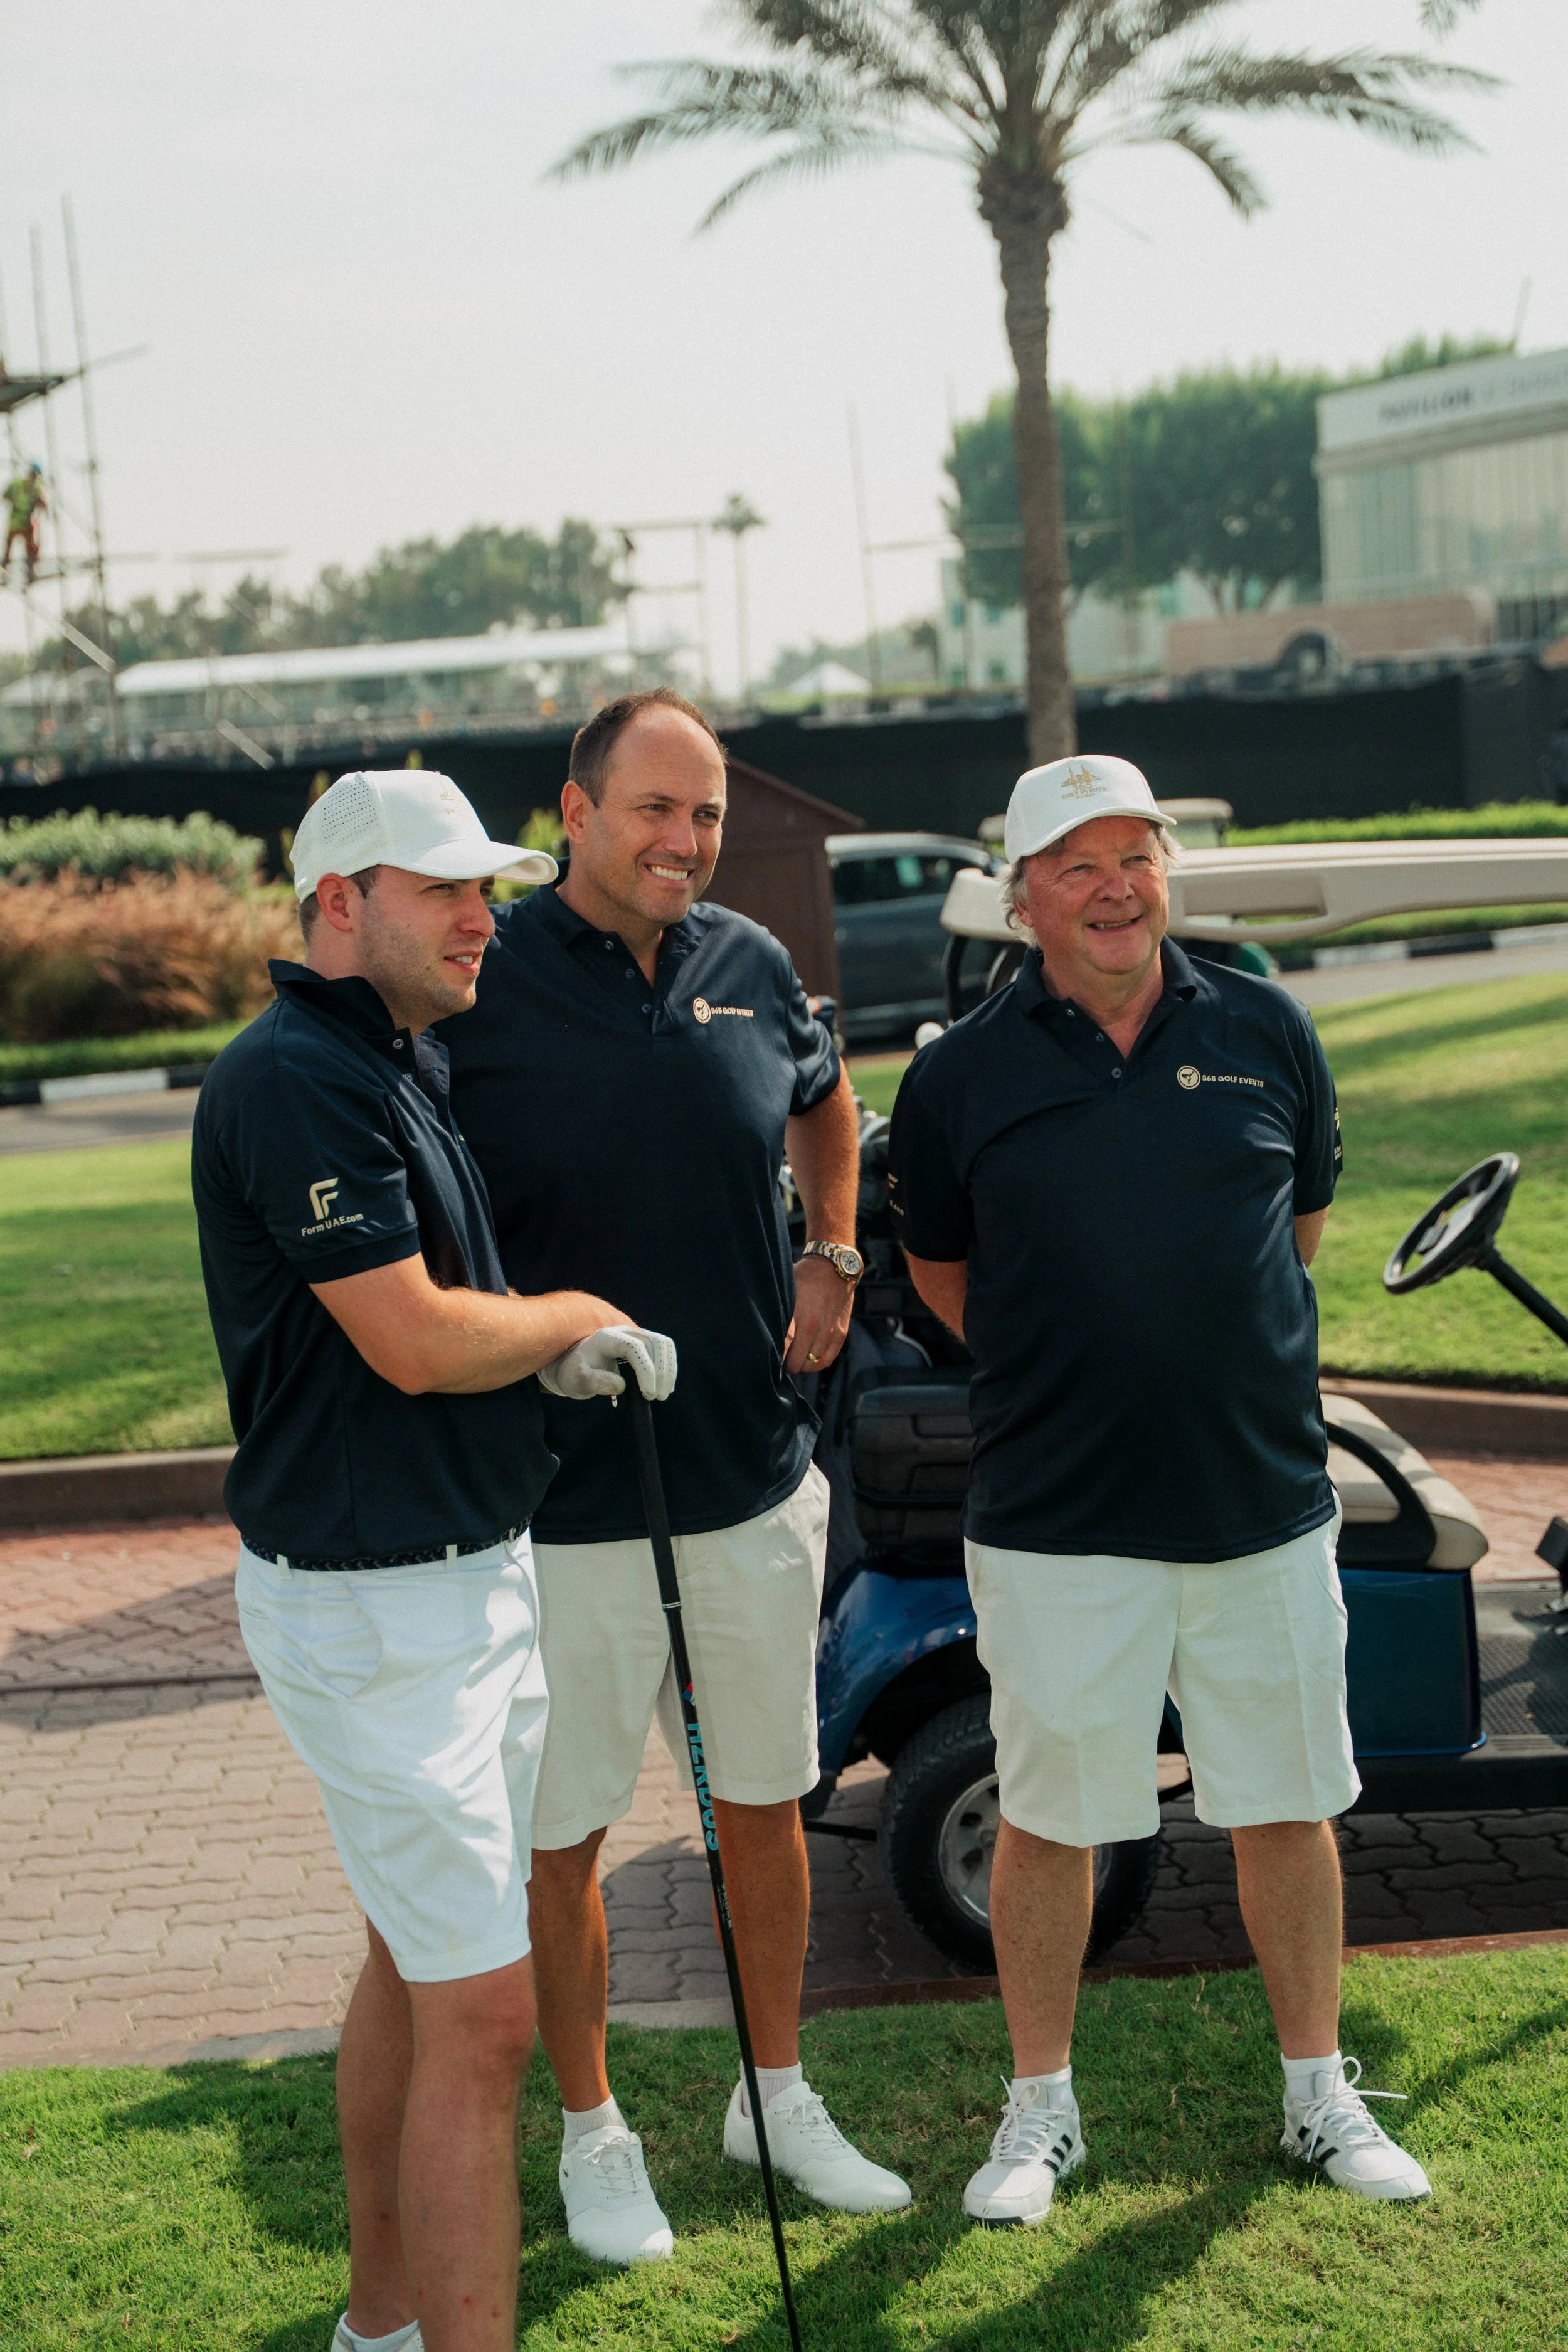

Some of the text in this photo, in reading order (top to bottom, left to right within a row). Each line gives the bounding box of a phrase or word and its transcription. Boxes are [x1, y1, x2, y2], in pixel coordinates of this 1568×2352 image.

[1073, 781, 1093, 792] 365
[1062, 791, 1079, 800] GOLF
[723, 1007, 736, 1015] GOLF
[736, 1008, 754, 1017] EVENTS
[1217, 1075, 1237, 1083] GOLF
[1239, 1078, 1264, 1088] EVENTS
[301, 1213, 364, 1237] Form UAE.com
